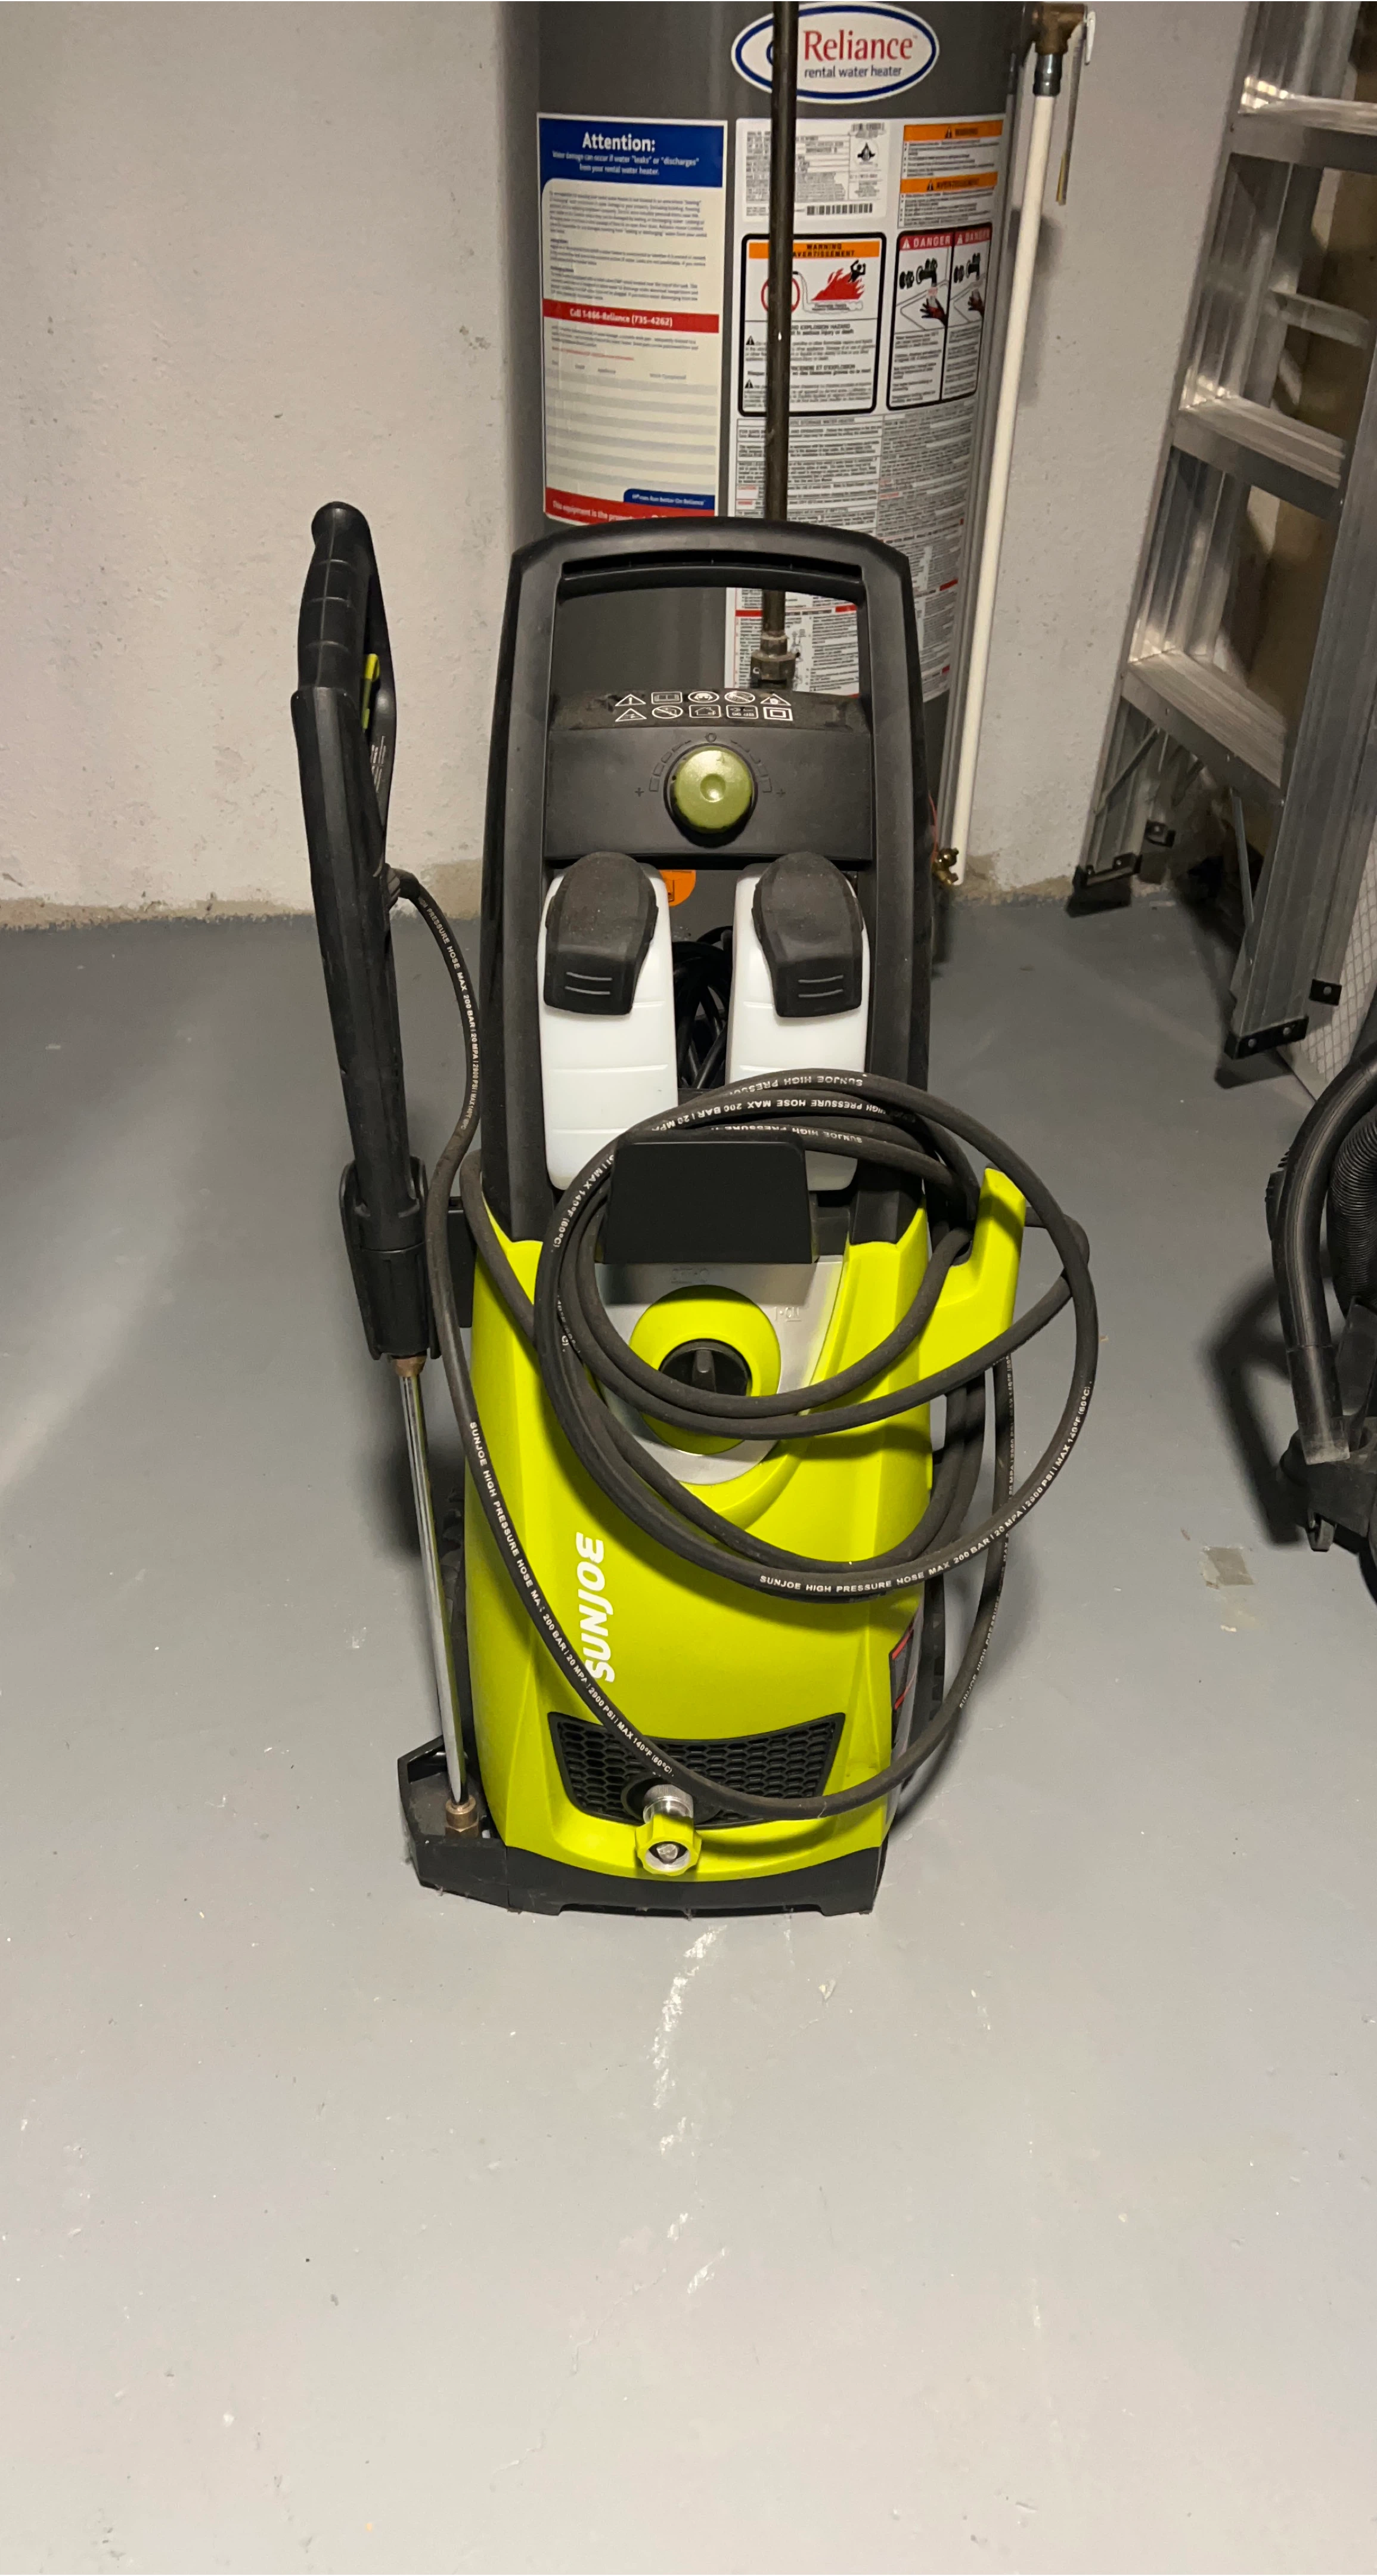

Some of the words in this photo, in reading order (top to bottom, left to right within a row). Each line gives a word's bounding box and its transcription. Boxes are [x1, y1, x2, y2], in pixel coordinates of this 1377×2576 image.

[803, 29, 913, 61] Reliance
[804, 66, 836, 78] rental
[839, 68, 868, 78] water
[871, 66, 903, 77] heater
[582, 131, 656, 153] Attention:
[913, 235, 951, 248] DANGER
[569, 308, 581, 317] Call
[446, 946, 461, 970] HOSE
[457, 971, 468, 991] MAX
[463, 994, 472, 1009] 200
[467, 1010, 476, 1027] BAR
[470, 1033, 477, 1042] 20
[783, 1075, 812, 1085] HIGH
[817, 1076, 863, 1087] SUNJOE
[724, 1103, 742, 1112] 200
[747, 1100, 771, 1109] MAX
[811, 1099, 863, 1110] PRESSURE
[697, 1106, 721, 1118] BAR
[677, 1114, 690, 1125] 20
[583, 1167, 603, 1190] MAX
[759, 1575, 802, 1590] SUNJOE
[805, 1583, 832, 1593] HIGH
[836, 1580, 892, 1593] PRESSURE
[896, 1571, 925, 1586] HOSE
[928, 1561, 951, 1575] MAX
[953, 1551, 970, 1564] 200
[970, 1537, 991, 1554] BAR
[994, 1525, 1005, 1537] 20
[1004, 1510, 1024, 1528] MPA
[1041, 1470, 1055, 1487] PSI
[1055, 1444, 1071, 1466] MAX
[469, 1422, 488, 1467] SUNJOE
[483, 1470, 497, 1497] HIGH
[493, 1500, 520, 1558] PRESSURE
[516, 1558, 534, 1589] HOSE
[542, 1613, 555, 1631] 200
[552, 1630, 567, 1652] BAR
[566, 1654, 576, 1666] 20
[573, 1664, 588, 1683] MPA
[602, 1705, 616, 1720] PSI
[616, 1721, 634, 1740] MAX
[575, 1531, 615, 1683] SUNJOE
